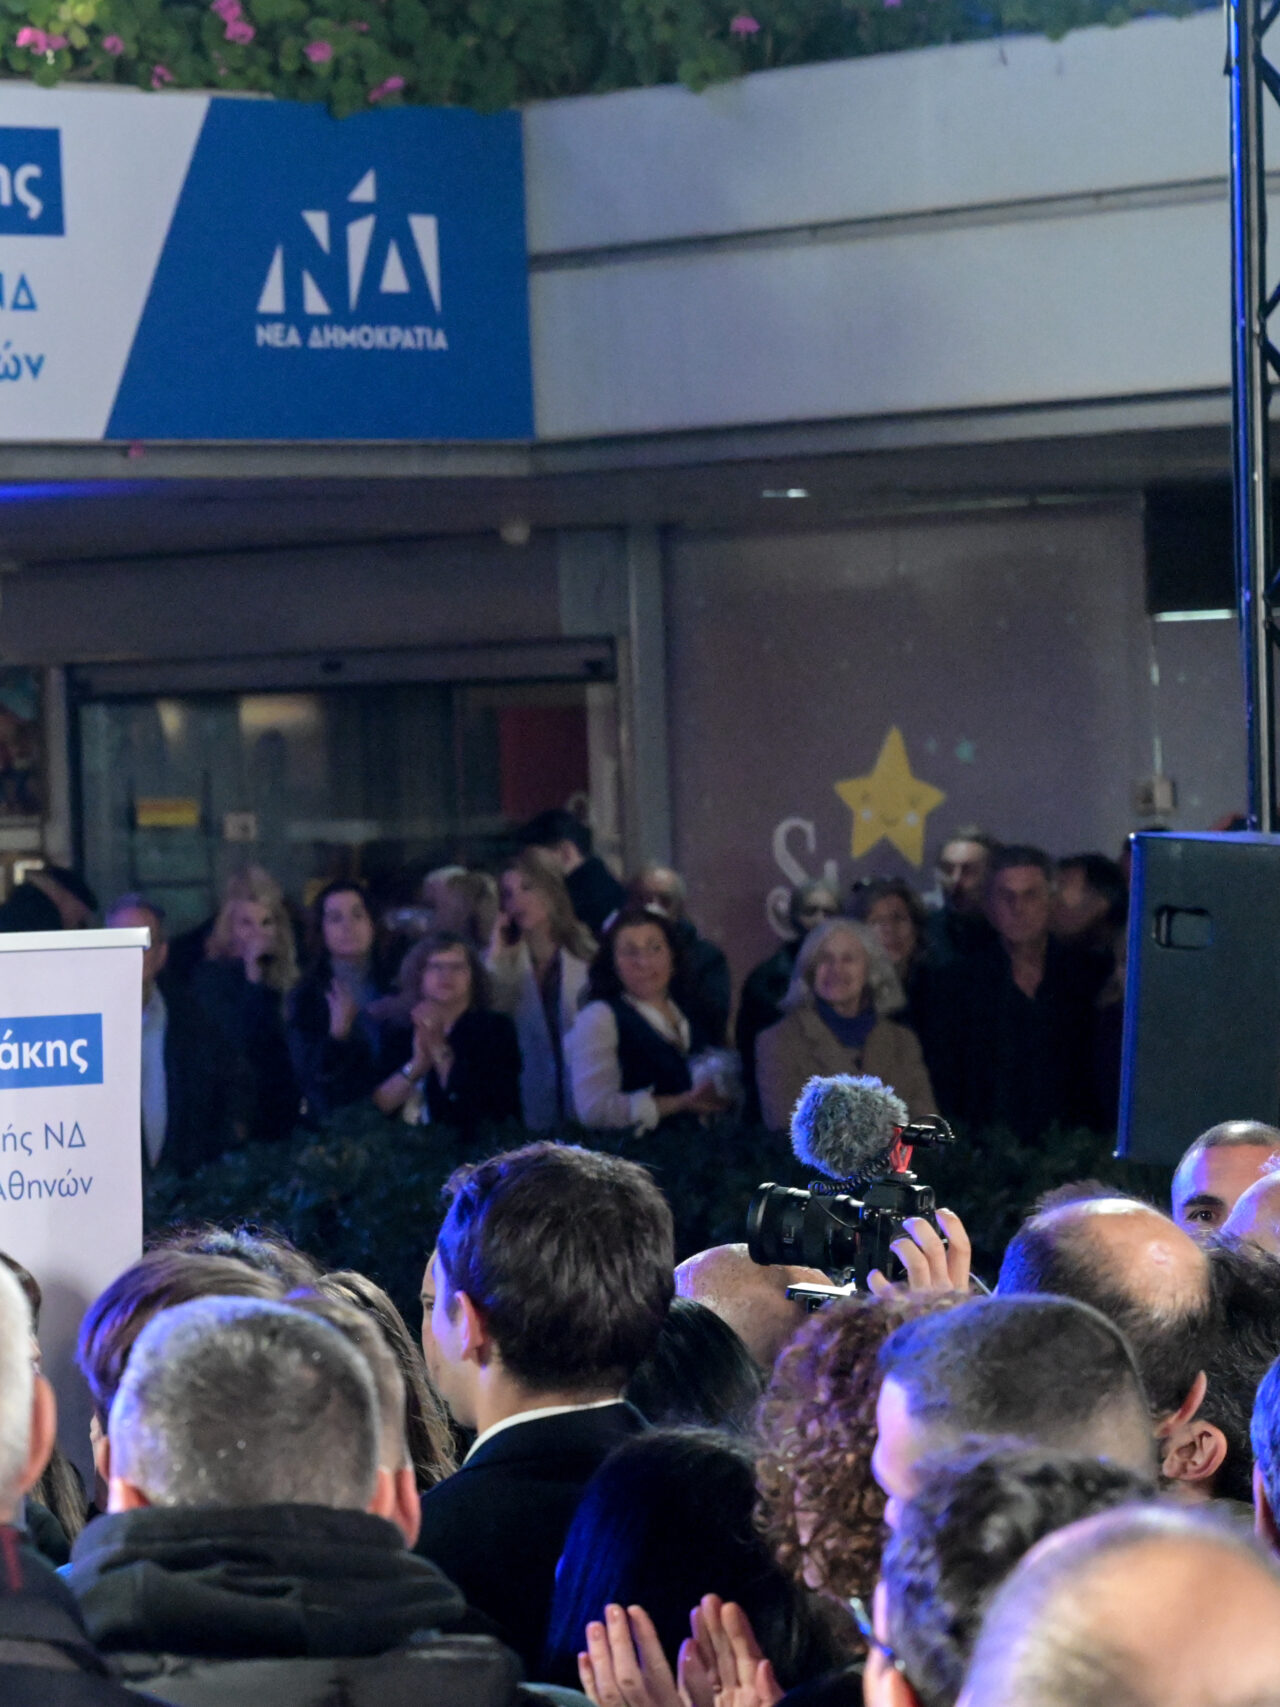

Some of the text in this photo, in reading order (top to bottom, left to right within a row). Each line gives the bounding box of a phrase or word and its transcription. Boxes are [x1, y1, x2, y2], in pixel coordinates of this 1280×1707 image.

[255, 323, 448, 350] ΝΕΑ ΔΗΜΟΚΡΑΤΙΑ
[45, 1121, 86, 1149] ΝΔ
